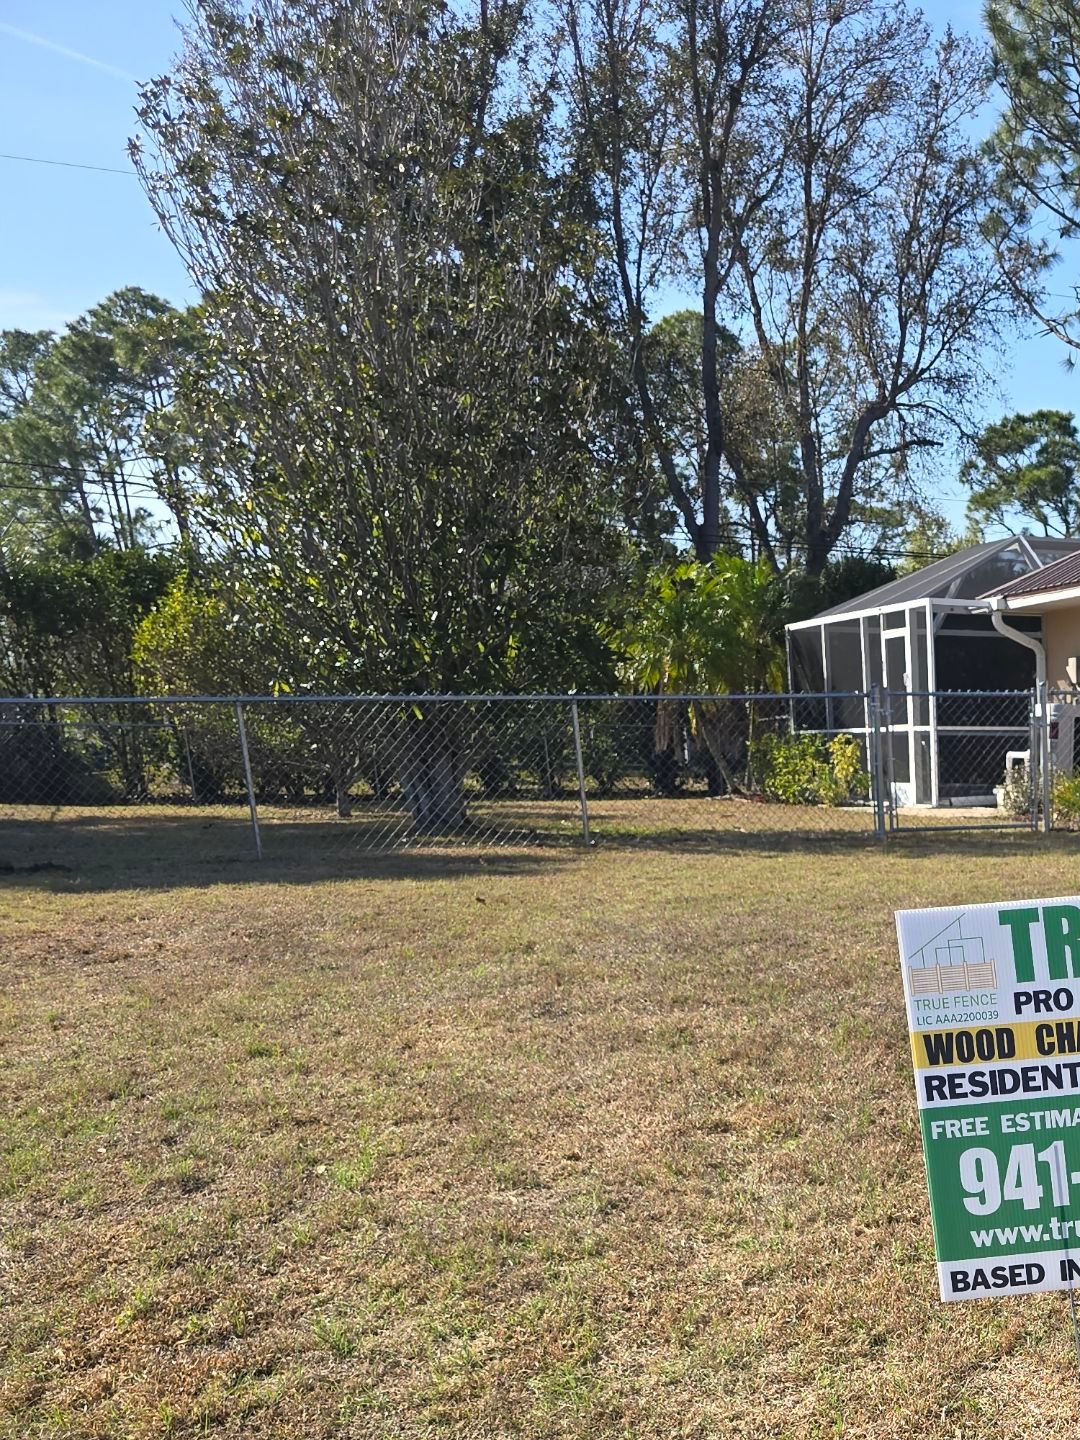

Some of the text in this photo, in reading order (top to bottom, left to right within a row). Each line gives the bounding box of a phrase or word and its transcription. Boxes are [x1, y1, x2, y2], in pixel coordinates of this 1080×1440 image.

[915, 993, 998, 1011] TRUE FENCE
[1013, 988, 1074, 1015] PRO
[917, 1009, 999, 1025] LIC AAA2200039
[922, 1028, 1015, 1065] WOOD
[931, 1117, 990, 1139] FREE
[950, 1263, 1045, 1292] BASED
